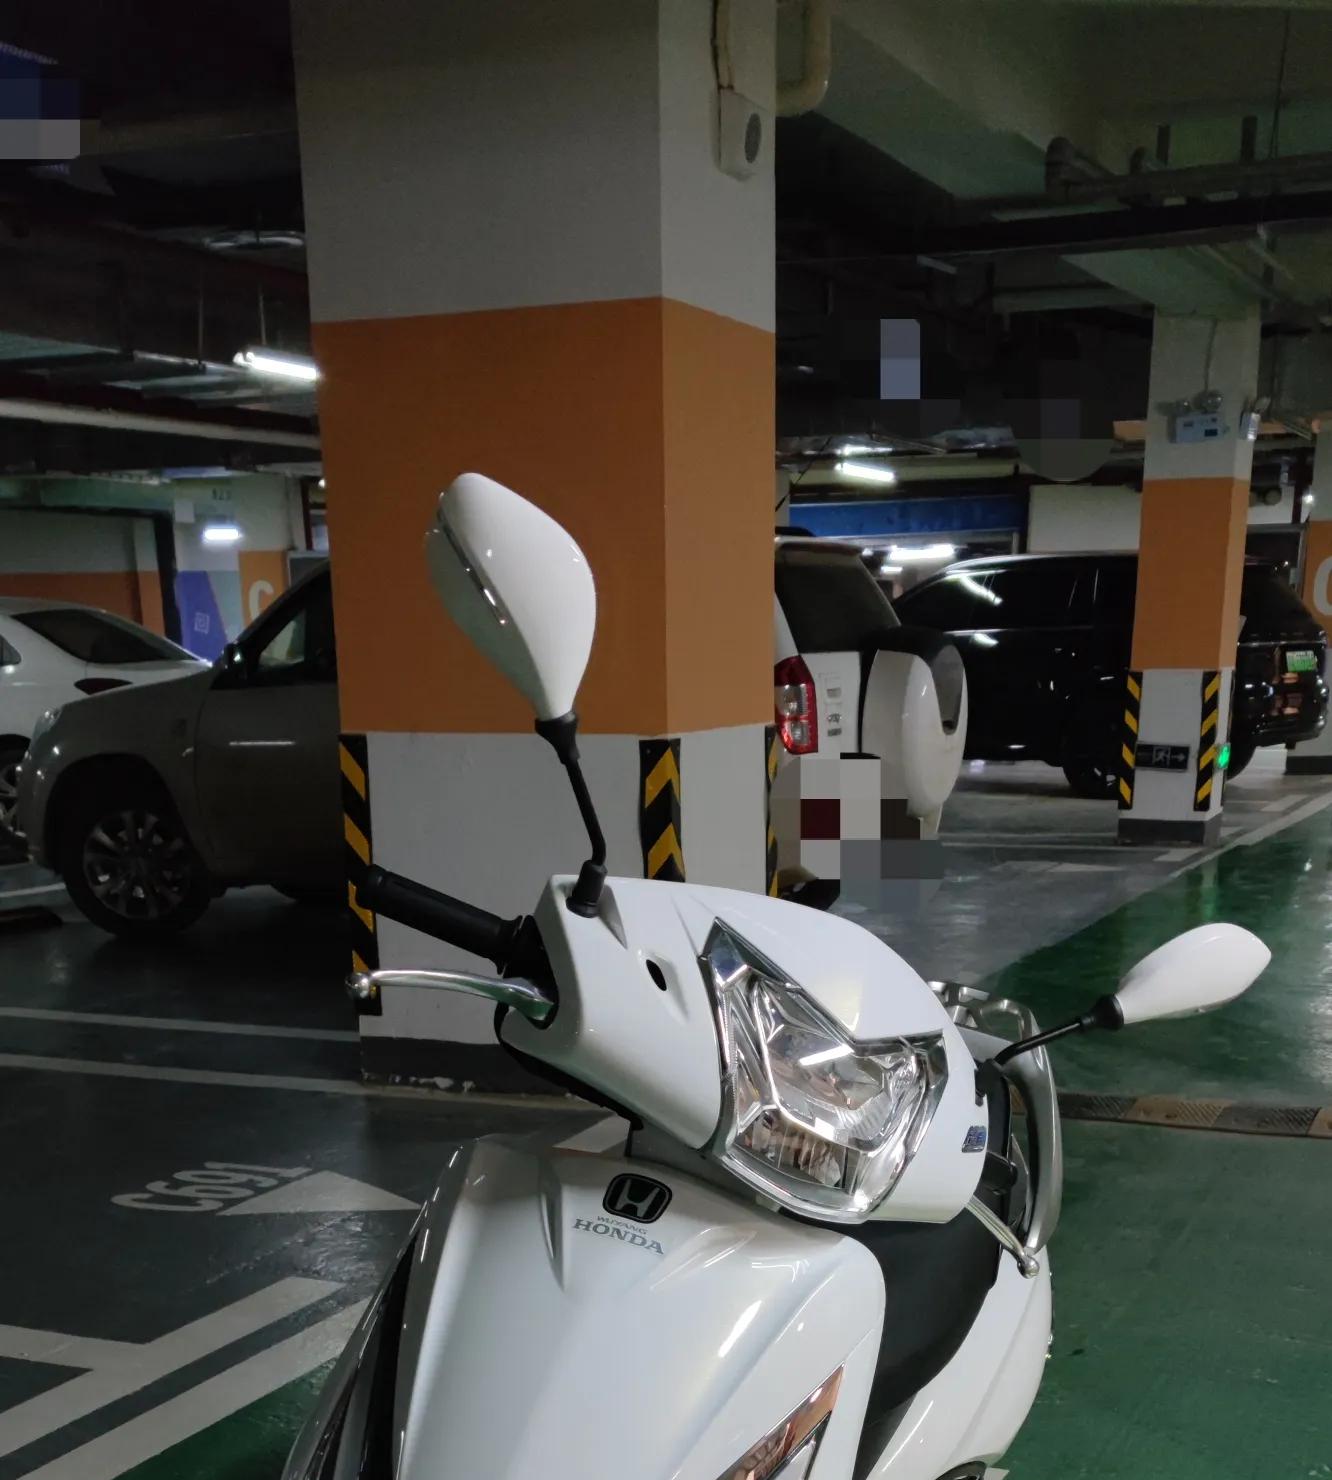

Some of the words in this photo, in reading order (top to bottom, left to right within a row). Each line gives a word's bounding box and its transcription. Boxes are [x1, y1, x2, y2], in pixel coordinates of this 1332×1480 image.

[110, 1160, 313, 1213] C691
[572, 1218, 664, 1255] HONDA
[597, 1215, 648, 1235] WUYANG
